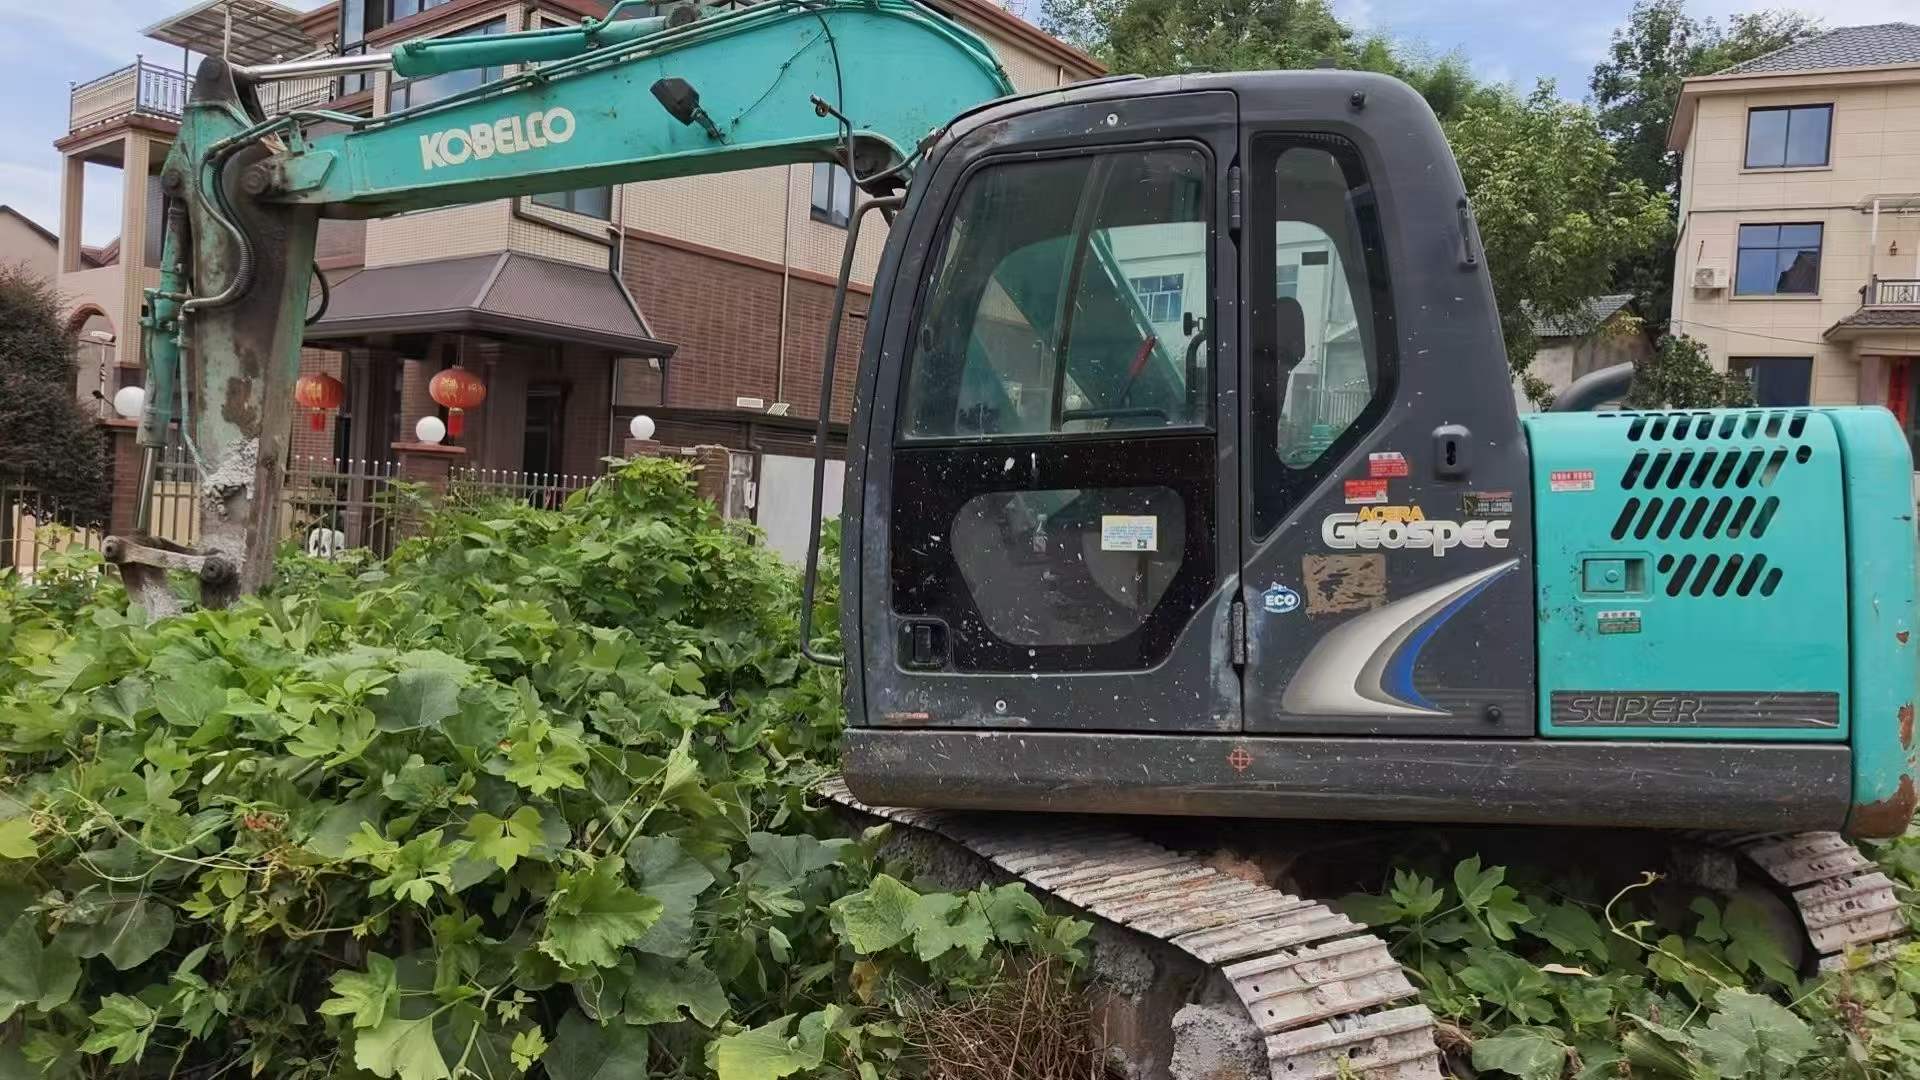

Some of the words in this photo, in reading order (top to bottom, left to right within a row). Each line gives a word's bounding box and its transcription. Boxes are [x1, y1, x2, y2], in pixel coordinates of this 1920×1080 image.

[420, 107, 575, 170] KOBELCO
[1265, 594, 1295, 606] ECO
[1564, 696, 1703, 724] SUPER
